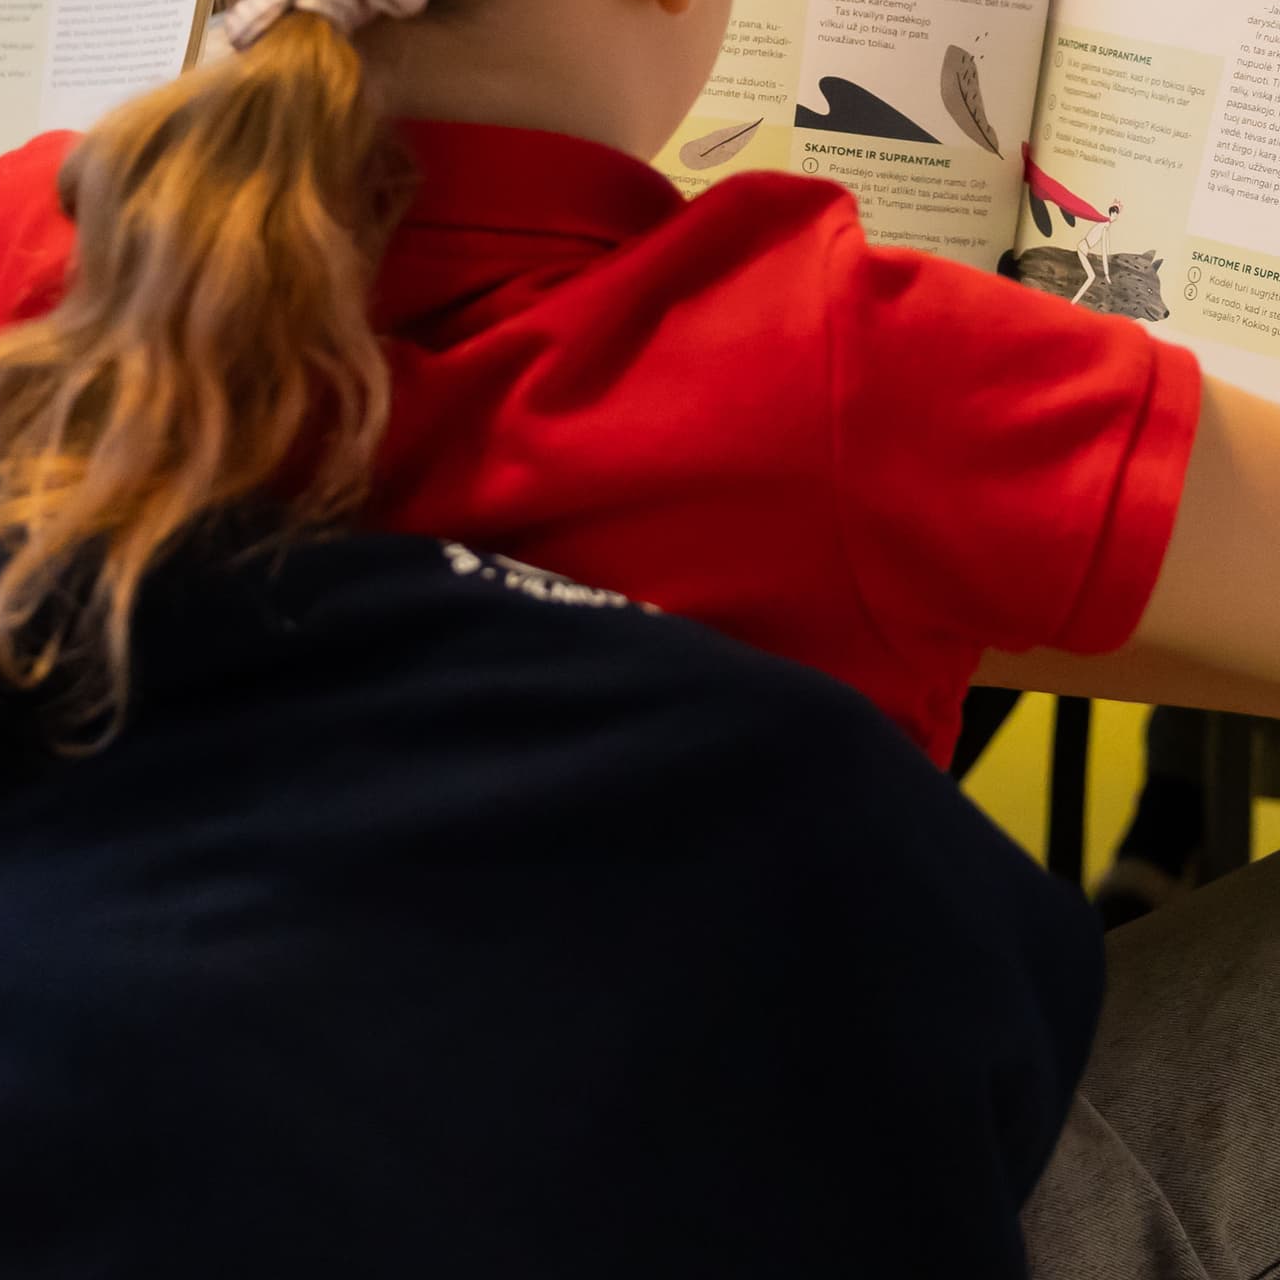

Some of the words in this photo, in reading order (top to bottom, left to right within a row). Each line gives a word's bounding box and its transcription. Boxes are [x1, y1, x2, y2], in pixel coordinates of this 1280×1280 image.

[1098, 46, 1152, 66] SUPRANTAME
[804, 142, 863, 158] SKAITOME
[865, 150, 877, 160] IR
[879, 152, 951, 168] SUPRANTAME
[1192, 251, 1241, 272] SKAITOME
[1242, 264, 1252, 274] IR
